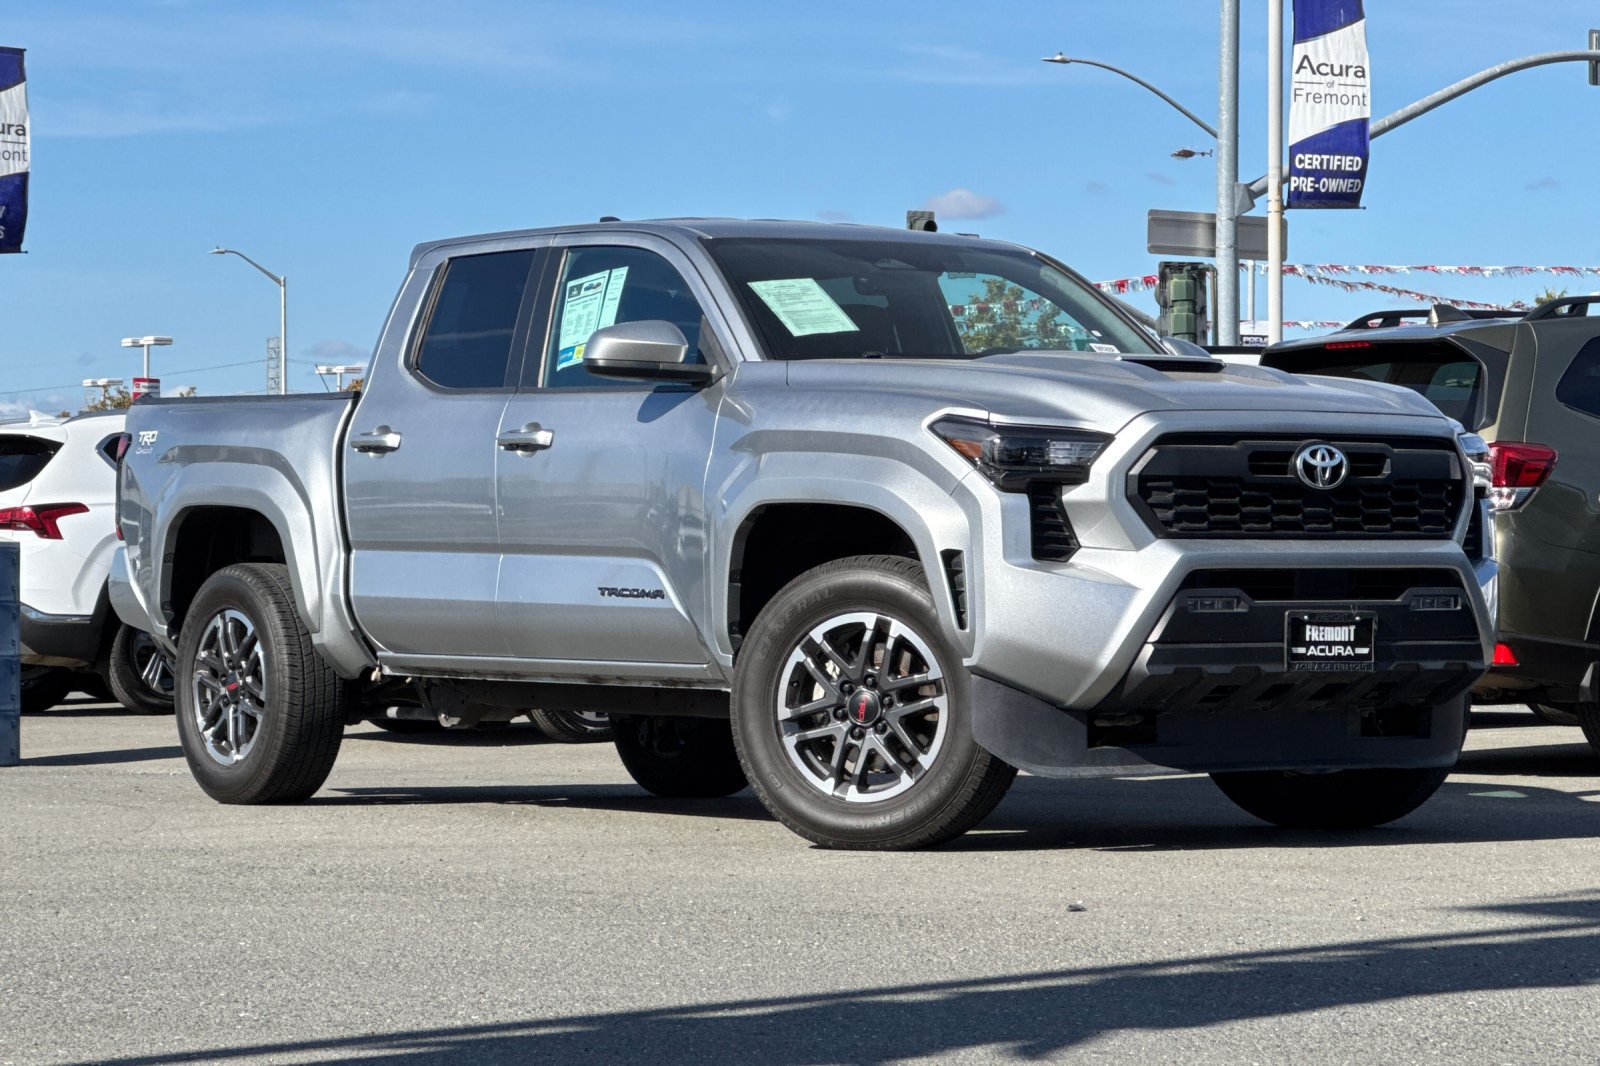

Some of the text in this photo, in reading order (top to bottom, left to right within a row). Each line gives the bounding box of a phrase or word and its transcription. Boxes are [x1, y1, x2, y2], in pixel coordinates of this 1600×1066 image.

[1295, 54, 1366, 79] Acura
[1326, 80, 1335, 88] of
[1293, 87, 1367, 107] Fremont
[1295, 153, 1363, 171] CERTIFIED
[1290, 176, 1362, 193] PRE-OWNED
[597, 586, 665, 600] TACOMA
[1305, 624, 1356, 642] FREMONT
[1306, 645, 1355, 656] ACURA
